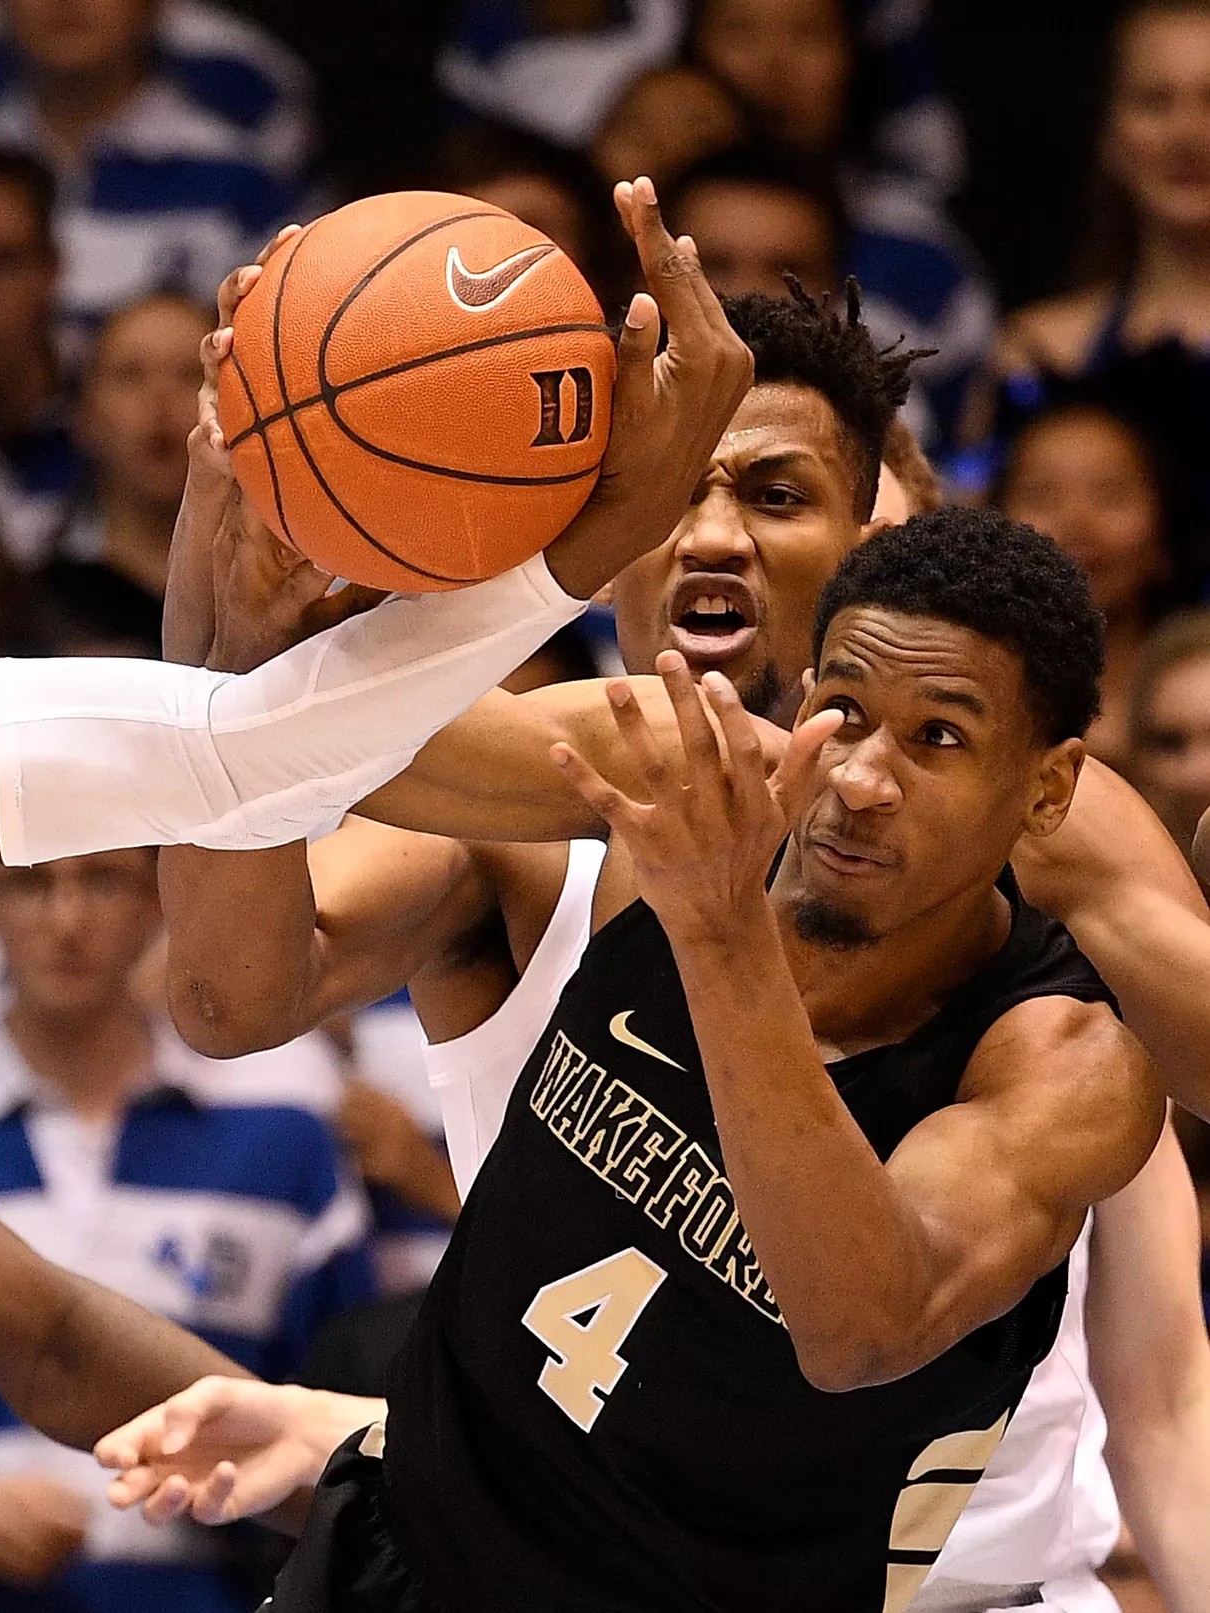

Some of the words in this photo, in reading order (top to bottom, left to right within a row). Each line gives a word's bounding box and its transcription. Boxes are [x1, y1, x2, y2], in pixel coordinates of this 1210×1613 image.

[530, 1029, 688, 1204] WAKE
[644, 1141, 789, 1331] FOR
[521, 1246, 668, 1434] 4
